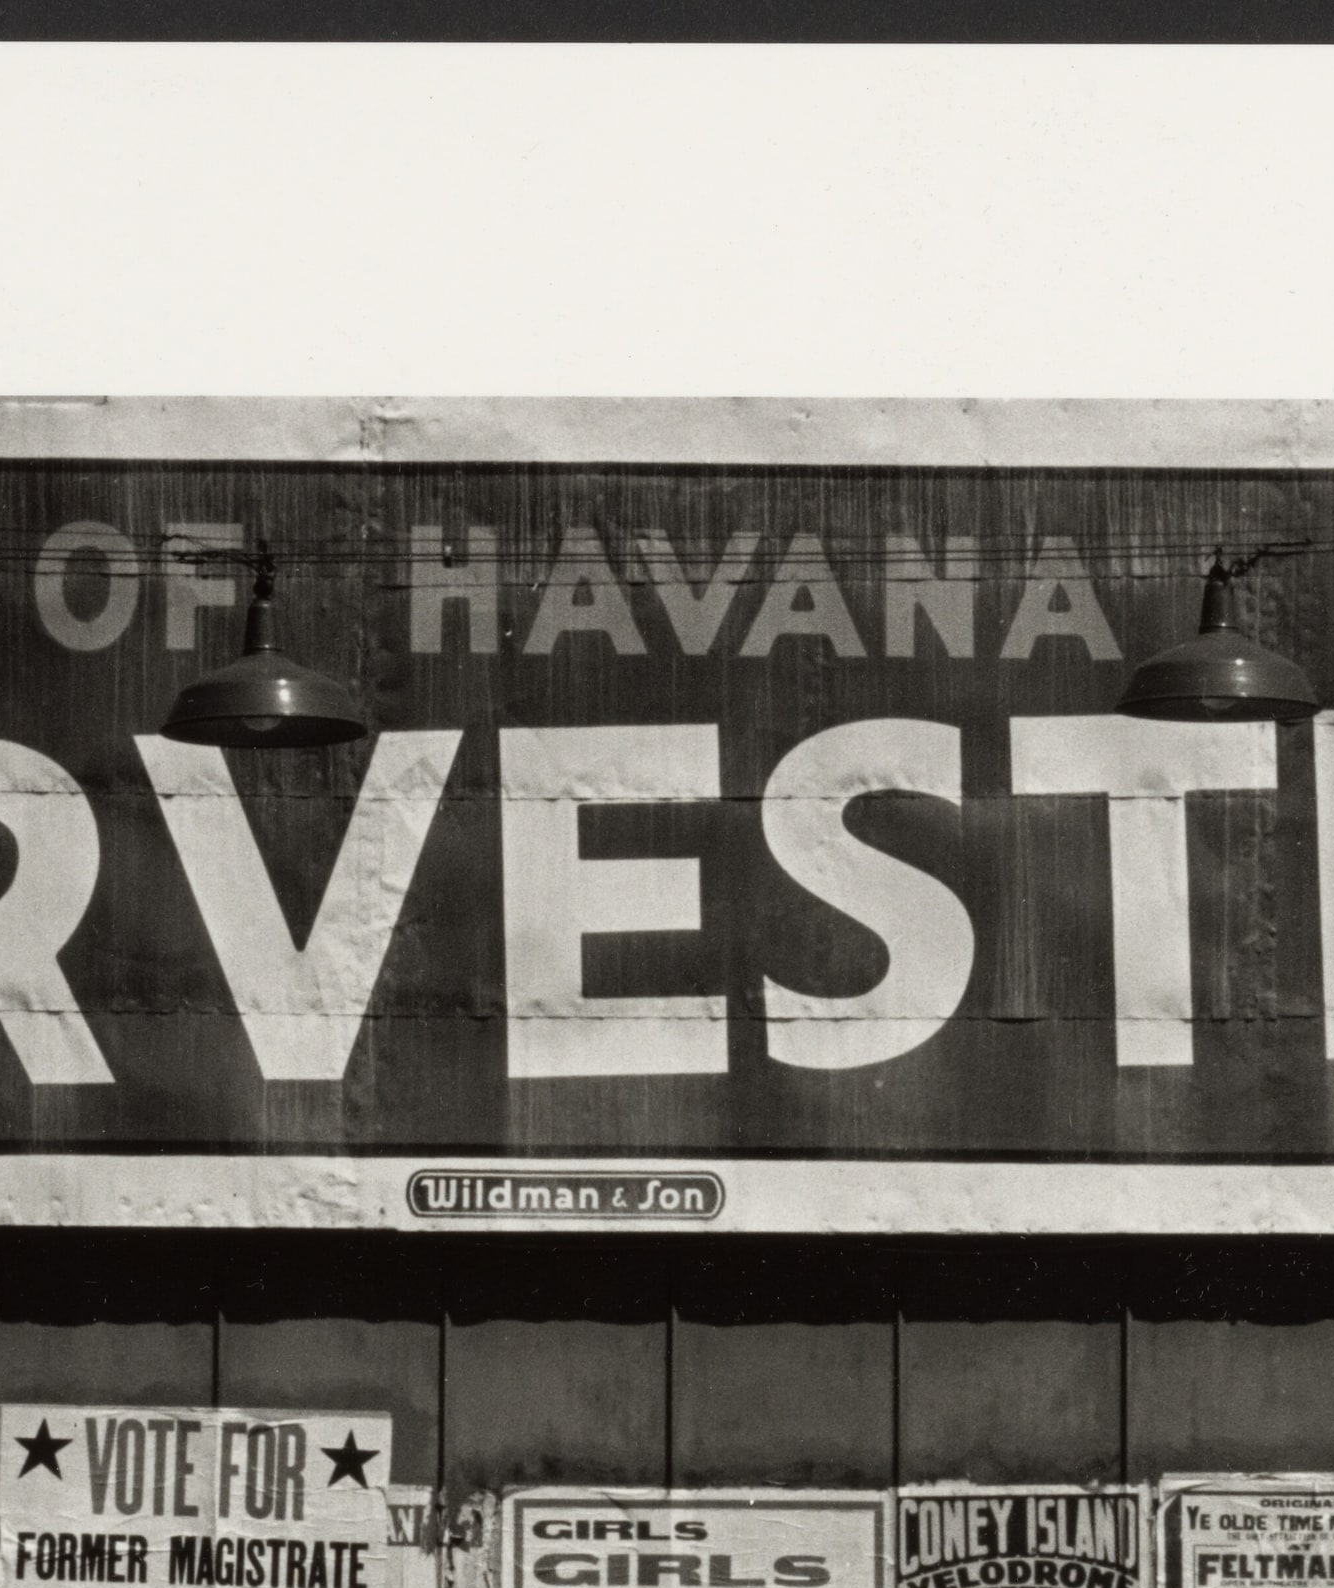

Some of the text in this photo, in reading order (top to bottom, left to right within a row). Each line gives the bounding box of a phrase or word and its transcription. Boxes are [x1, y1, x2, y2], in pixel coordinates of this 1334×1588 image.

[33, 519, 244, 651] OF
[409, 523, 1123, 661] HAVANA
[421, 1179, 704, 1210] Wildman & Son
[85, 1417, 307, 1521] VOTE FOR
[532, 1519, 709, 1542] GIRLS
[899, 1497, 1137, 1577] CONEY ISLAND
[1219, 1514, 1267, 1531] OLDE
[1277, 1514, 1323, 1531] TIME
[16, 1532, 148, 1584] FORMER
[533, 1552, 832, 1588] GIRLS
